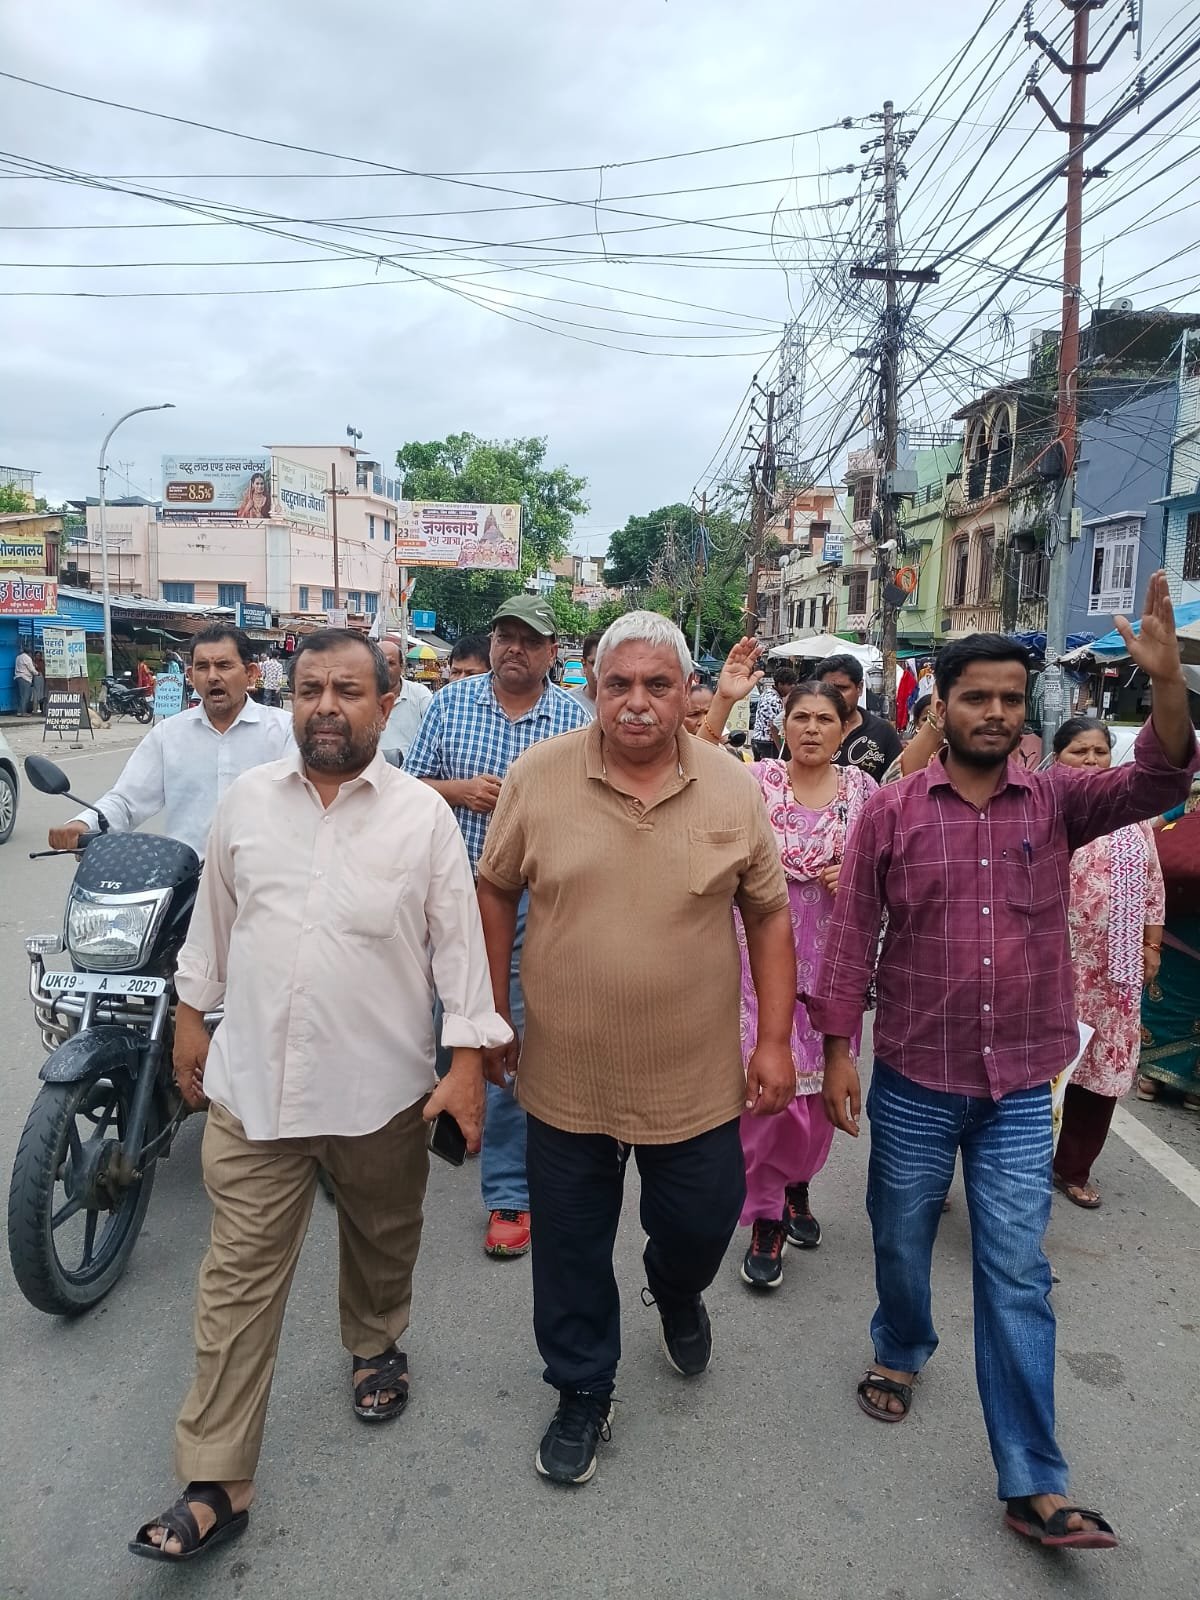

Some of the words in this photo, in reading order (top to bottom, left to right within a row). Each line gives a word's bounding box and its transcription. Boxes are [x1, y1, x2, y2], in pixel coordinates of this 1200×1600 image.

[194, 462, 209, 472] लाल
[210, 462, 224, 472] एण्ड
[225, 462, 241, 472] सन्स
[398, 527, 409, 538] 23
[421, 521, 478, 536] जगन्नाथ
[428, 536, 439, 547] रथ
[441, 536, 461, 546] यात्रा
[12, 576, 45, 601] होटल
[48, 693, 81, 704] ADHIKARI
[99, 880, 123, 890] TVS
[45, 974, 77, 988] UK19
[98, 977, 108, 990] A
